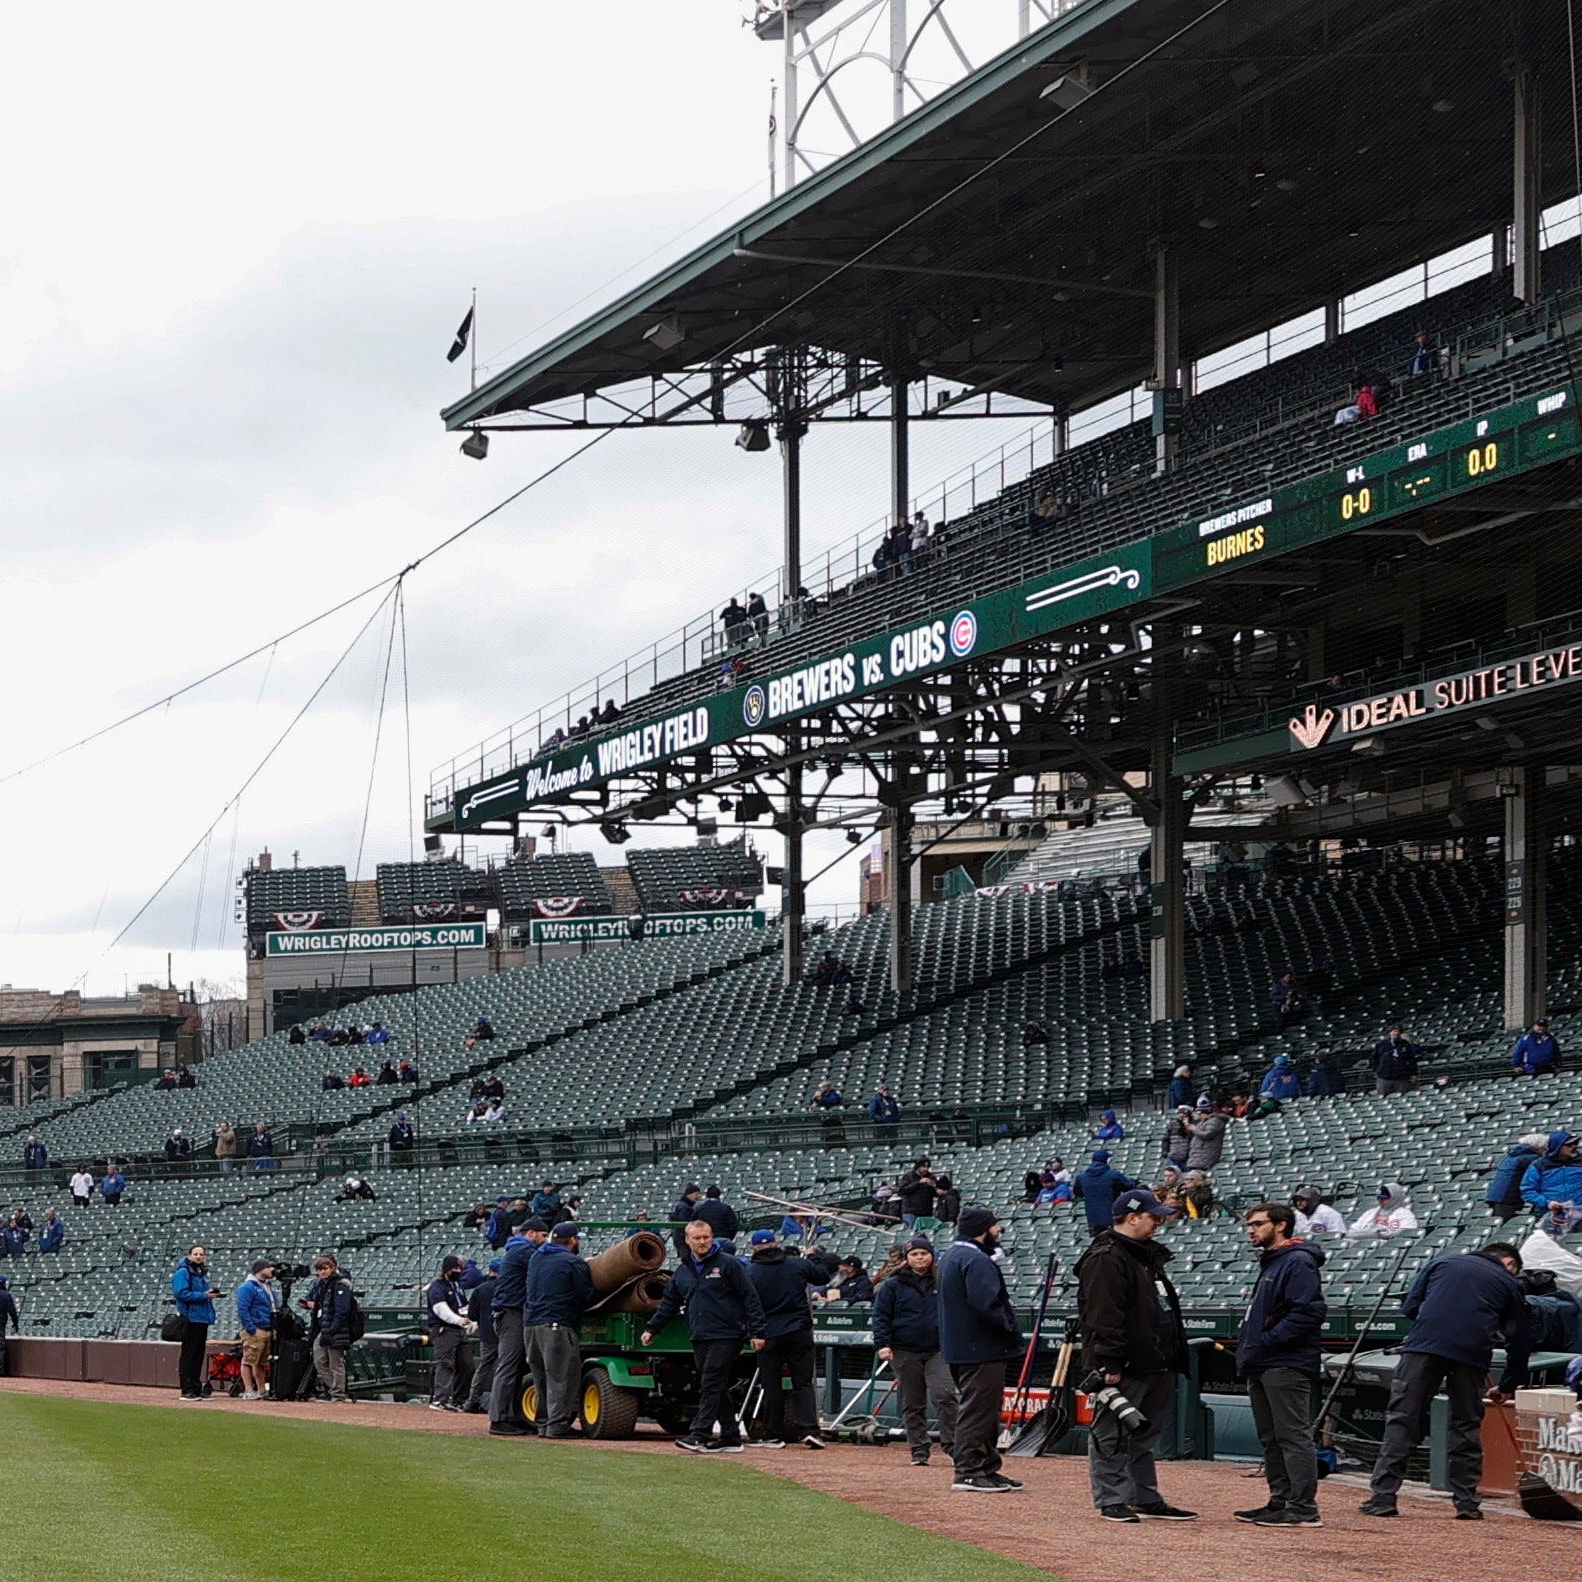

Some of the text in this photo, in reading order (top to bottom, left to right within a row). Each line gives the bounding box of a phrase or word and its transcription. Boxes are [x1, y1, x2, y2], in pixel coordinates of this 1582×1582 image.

[1468, 442, 1498, 476] 0.0
[1237, 499, 1272, 524] PITCHER
[1341, 488, 1371, 520] 0-0
[1207, 524, 1265, 567] BURNES
[768, 652, 856, 719] BREWERS
[890, 620, 946, 677] CUBS
[1341, 690, 1426, 733] IDEAL
[1435, 664, 1508, 709] SUITE
[526, 706, 709, 801] Welcome to WRIGLEY FIELD
